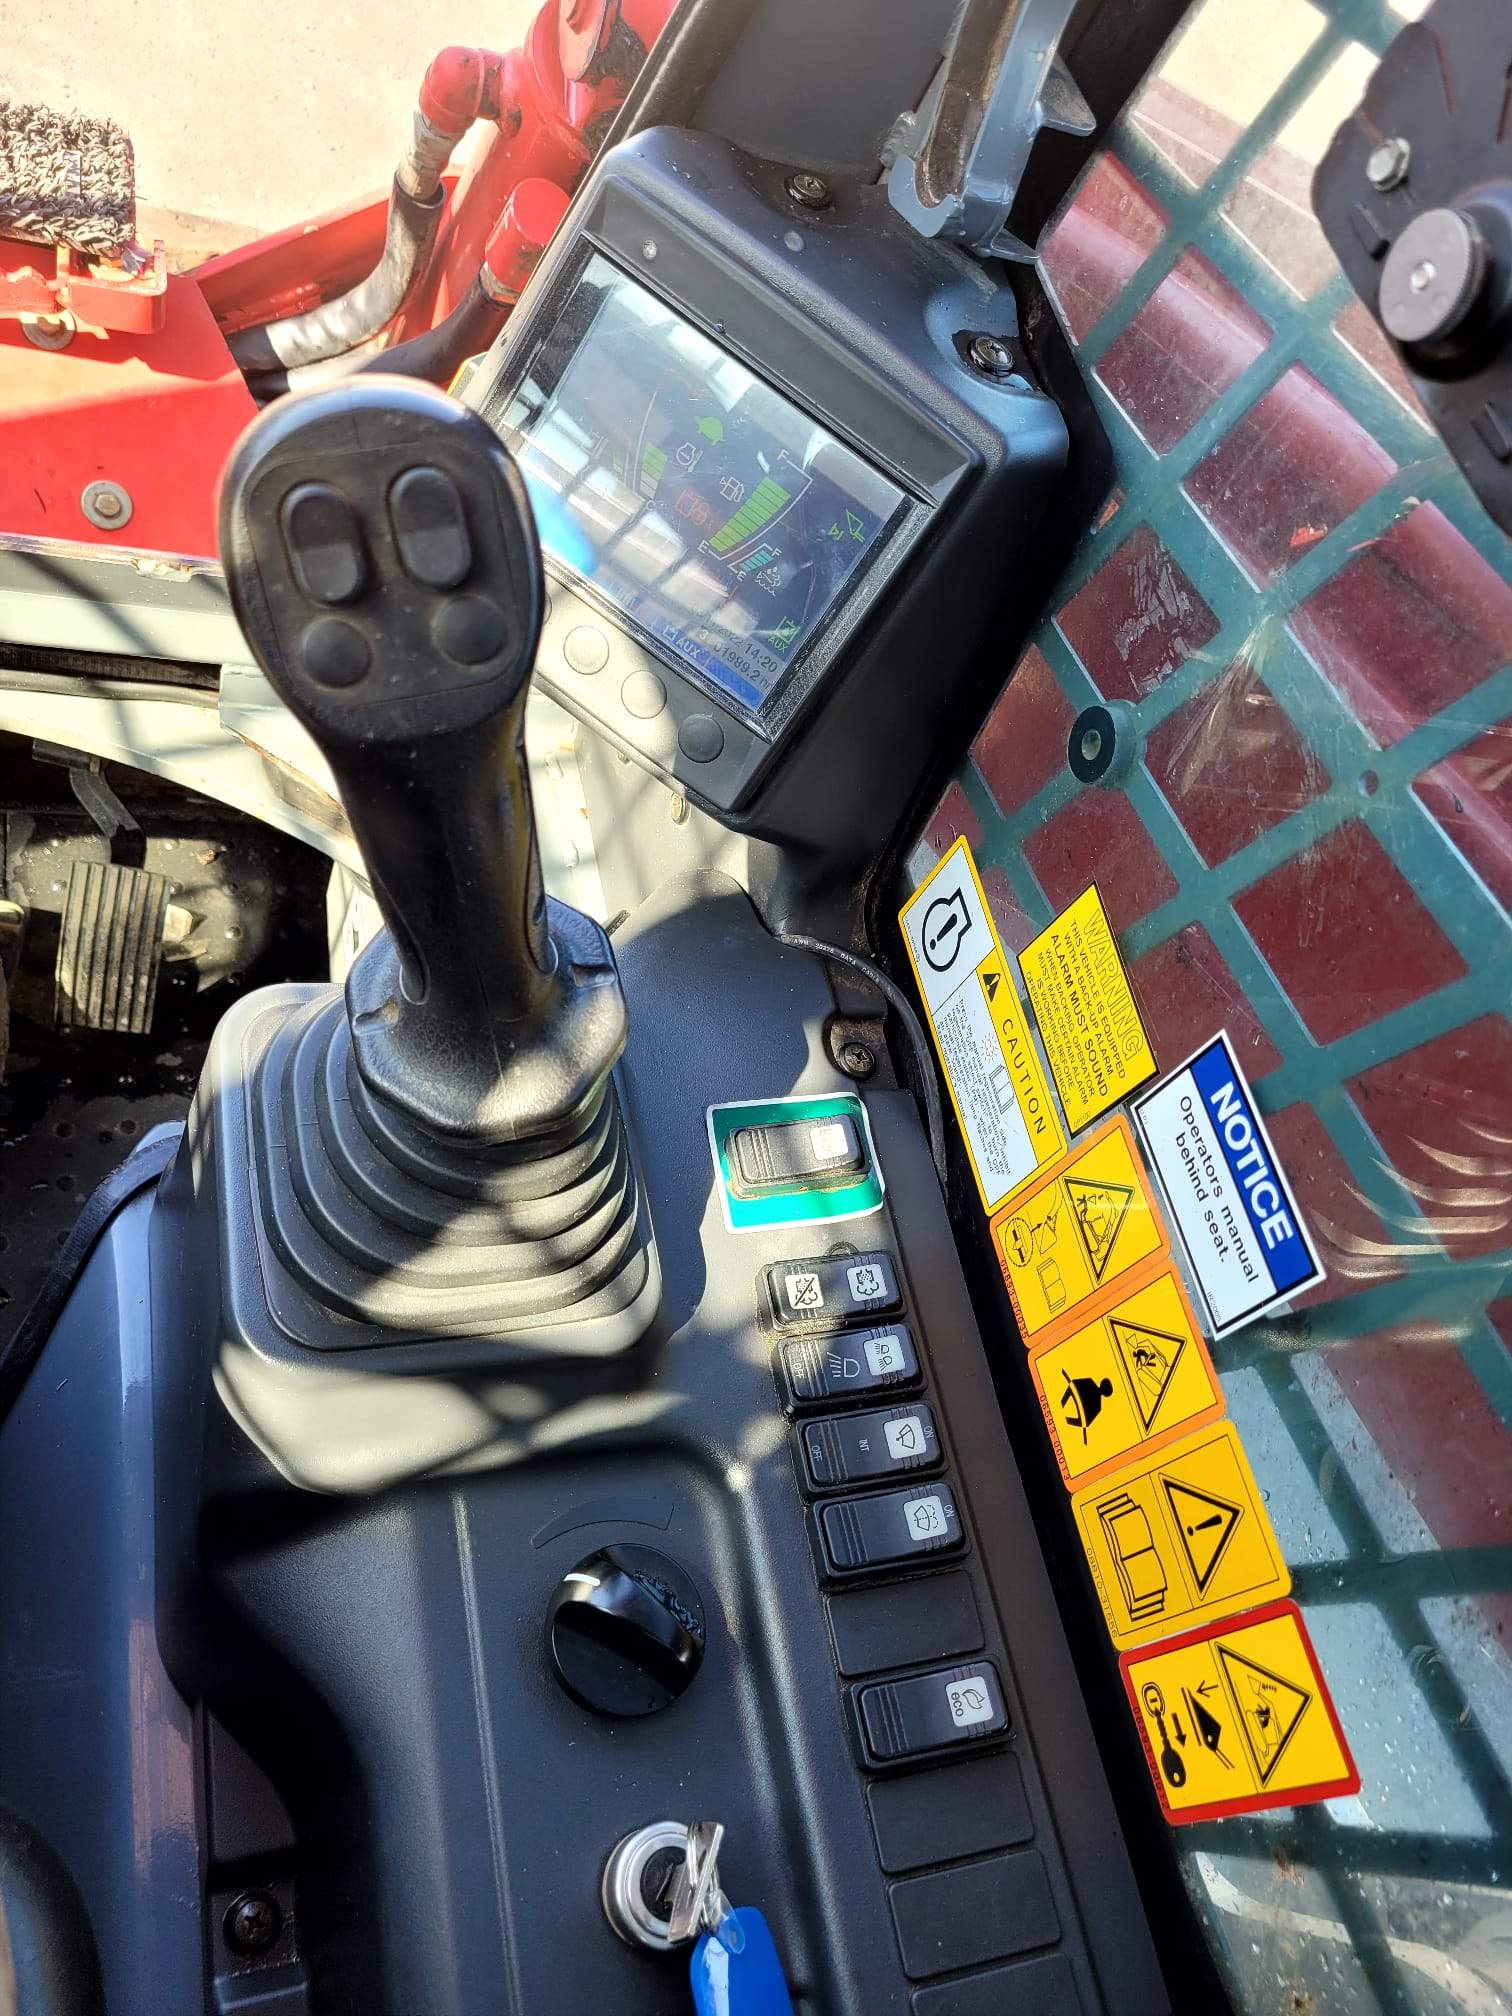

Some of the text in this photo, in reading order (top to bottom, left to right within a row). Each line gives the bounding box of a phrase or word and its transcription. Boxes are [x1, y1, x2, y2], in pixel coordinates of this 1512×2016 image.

[777, 449, 790, 462] F
[697, 540, 710, 554] E
[736, 571, 747, 582] E
[771, 548, 782, 559] F
[676, 637, 701, 659] AUX
[745, 643, 778, 673] 14:20
[768, 636, 788, 654] AUX
[1026, 970, 1048, 1032] OPERATING
[1045, 1033, 1055, 1056] THIS
[1036, 977, 1043, 990] IS
[1040, 990, 1059, 1043] WORKING
[1045, 947, 1058, 981] WHEN
[1072, 1035, 1095, 1096] OPERATOR
[1050, 934, 1108, 1096] ALARM MUST SOUND
[1063, 932, 1077, 964] WITH
[1076, 974, 1099, 1029] BACK-UP
[1094, 1032, 1114, 1076] ALARM.
[1070, 920, 1126, 1079] THIS VEHICLE IS EQUIPPED
[1083, 908, 1144, 1061] WARNING
[1037, 951, 1050, 981] MUST
[1047, 982, 1060, 1012] MAKE
[1057, 1016, 1075, 1064] CERTAIN
[1072, 1065, 1089, 1105] ALARM
[972, 1040, 983, 1070] manual
[981, 1072, 1001, 1125] regeneration
[999, 1127, 1007, 1146] side
[1002, 1018, 1046, 1134] CAUTION
[1175, 1131, 1229, 1262] behind seat.
[1179, 1095, 1259, 1282] Operators manual
[1211, 1082, 1292, 1248] NOTICE
[792, 1363, 805, 1379] OFF
[811, 1425, 935, 1462] OFF INT ON
[944, 1504, 954, 1518] ON
[951, 1692, 964, 1717] eco
